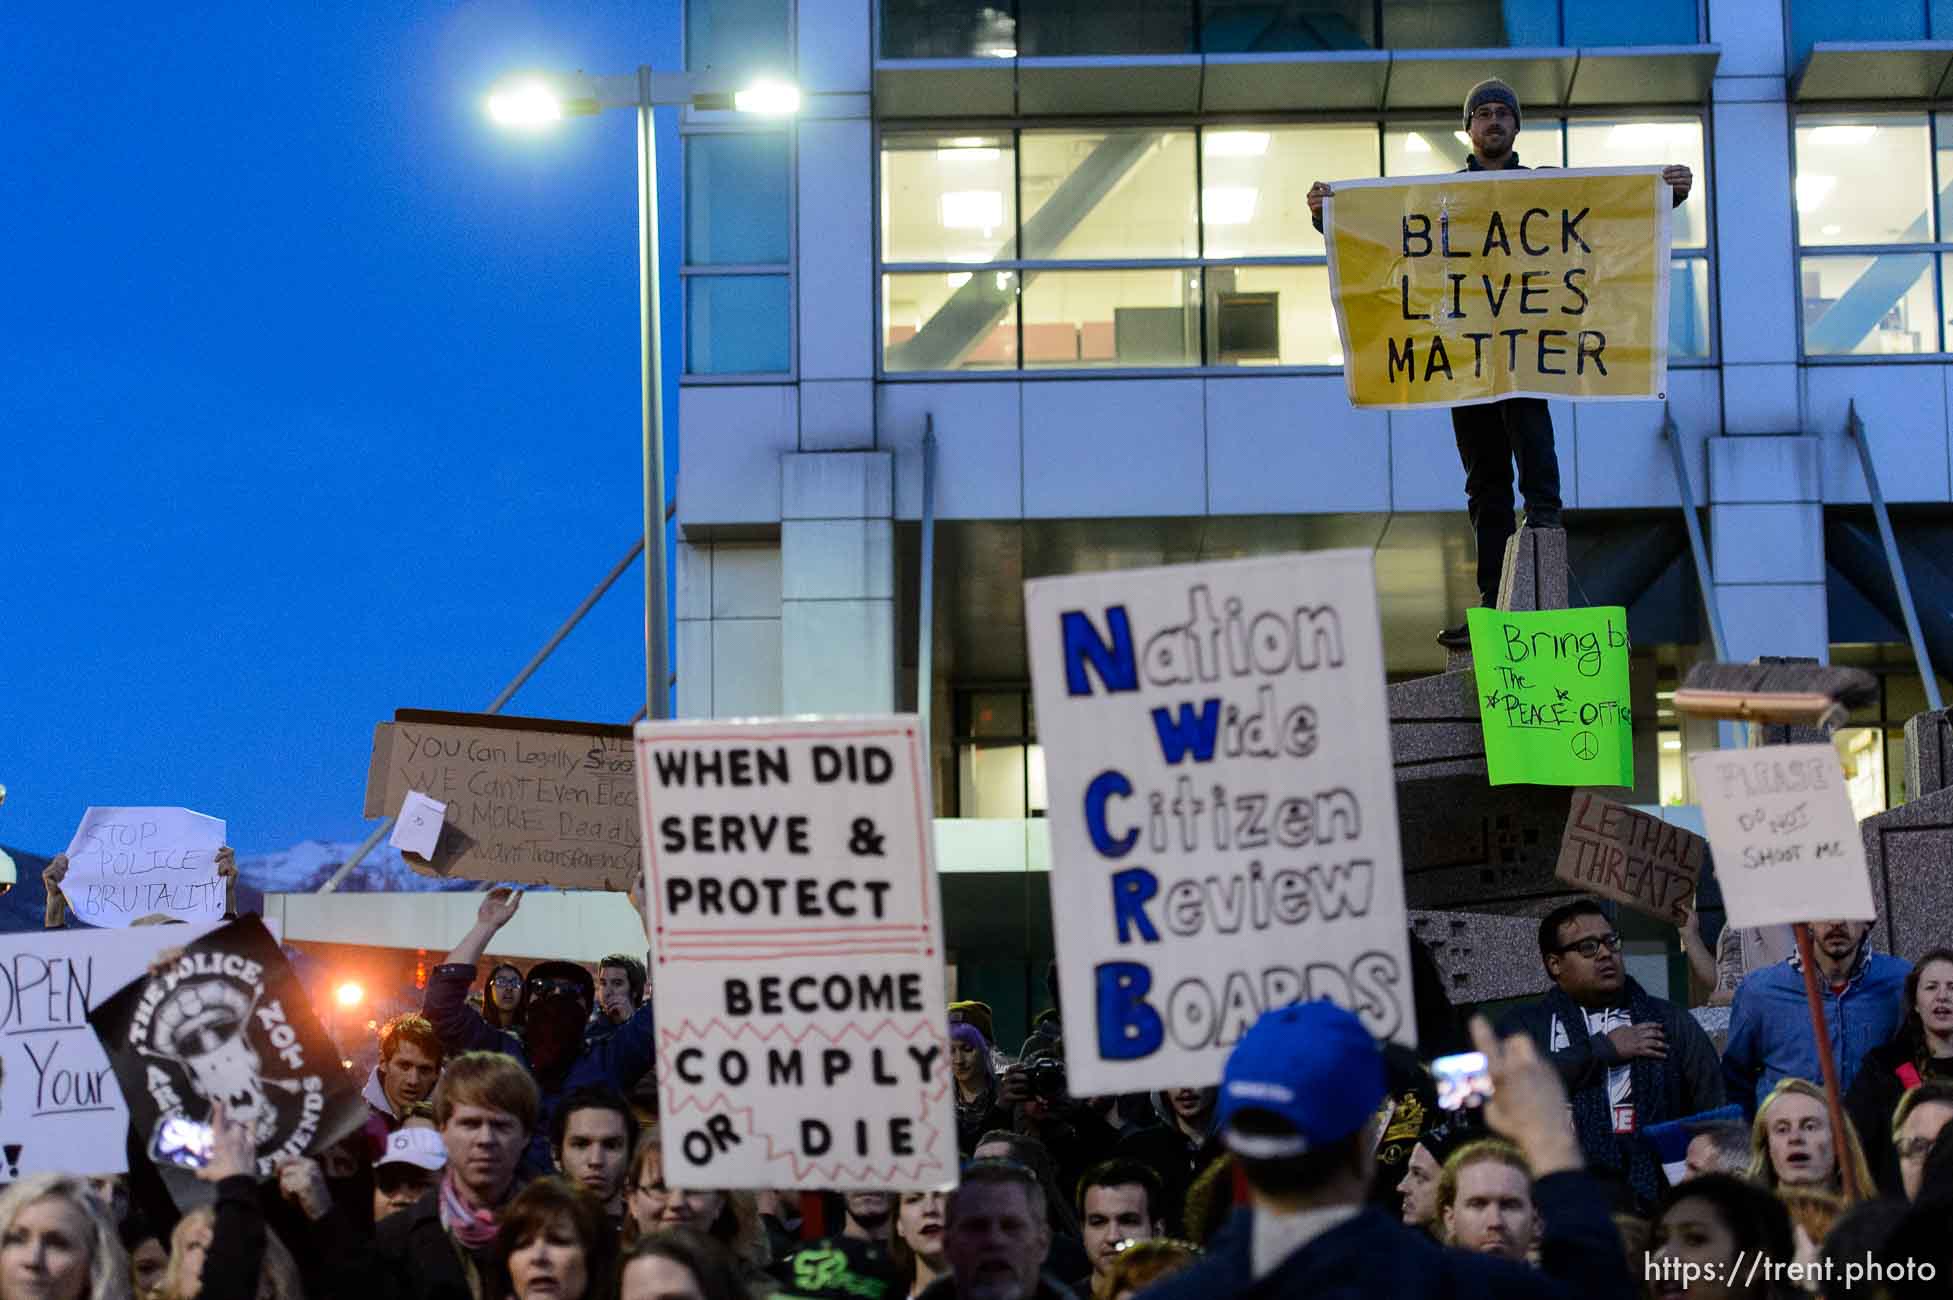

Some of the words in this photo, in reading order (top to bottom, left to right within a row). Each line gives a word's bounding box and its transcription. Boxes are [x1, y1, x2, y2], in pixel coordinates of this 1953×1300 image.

[1402, 207, 1592, 258] BLACK
[1402, 268, 1589, 320] LIVES
[1387, 329, 1608, 384] MATTER
[1060, 584, 1344, 697] Nation
[1503, 623, 1602, 677] Bring
[1494, 666, 1536, 689] The
[401, 727, 461, 763] YOU
[654, 746, 790, 788] WHEN
[811, 744, 894, 785] DID
[400, 767, 457, 793] WE
[597, 782, 637, 808] Elec
[87, 821, 158, 848] STOP
[660, 814, 811, 855] SERVE
[849, 816, 886, 857] &
[1083, 769, 1361, 858] Citizen
[1572, 793, 1696, 871] LETHAL
[100, 849, 201, 880] POLICE
[666, 877, 892, 919] PROTECT
[1110, 858, 1375, 944] Review
[724, 973, 924, 1017] BECOME
[256, 1000, 304, 1070] NOT
[23, 1040, 113, 1109] Your
[675, 1045, 940, 1087] COMPLY
[682, 1113, 742, 1167] OR
[801, 1117, 916, 1157] DIE
